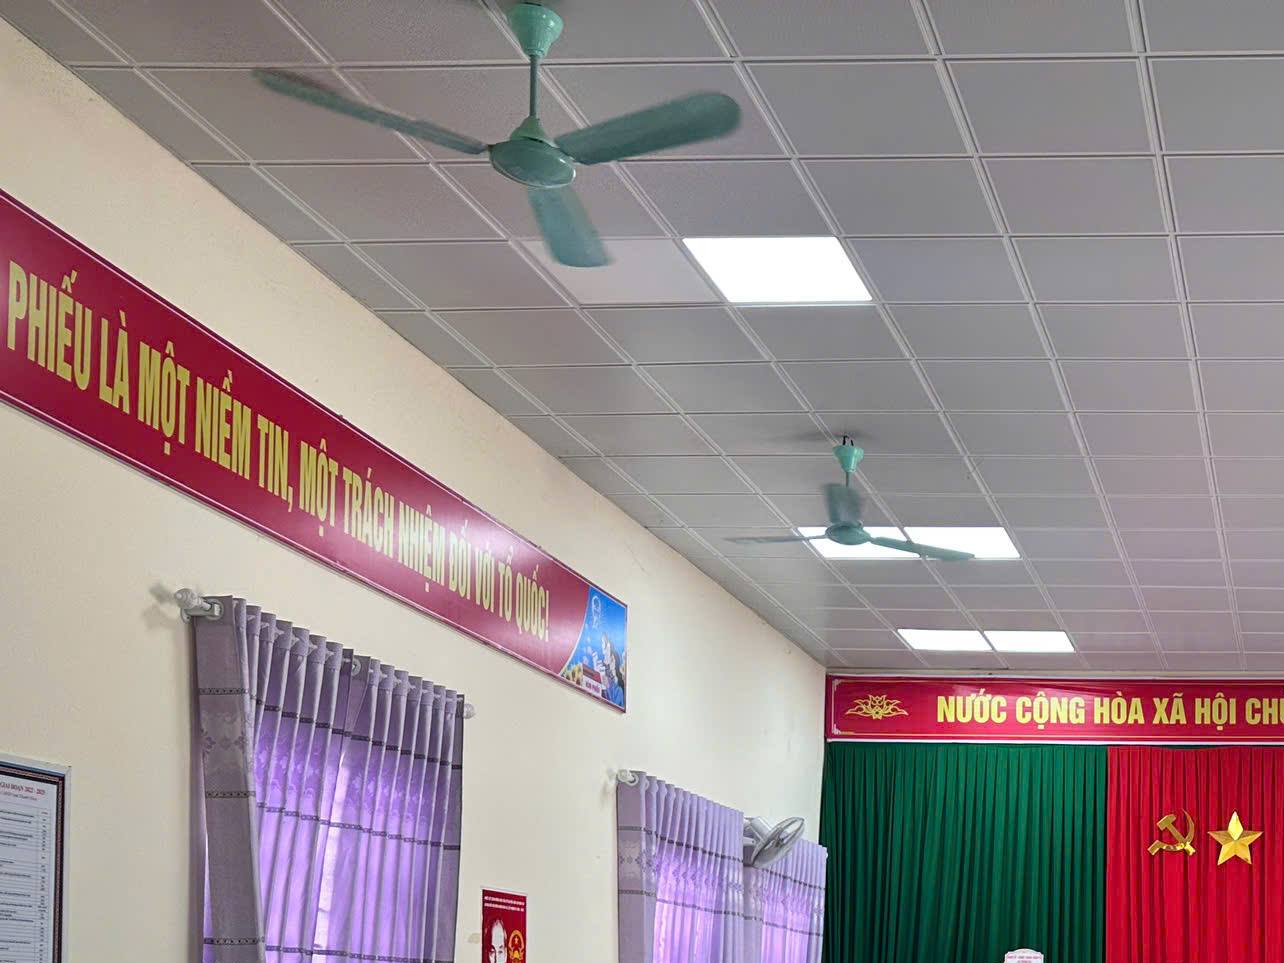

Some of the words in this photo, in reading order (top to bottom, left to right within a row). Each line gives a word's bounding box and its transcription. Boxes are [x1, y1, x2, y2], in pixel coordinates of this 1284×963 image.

[7, 260, 92, 391] PHIẾU
[99, 310, 130, 414] LÀ
[137, 340, 190, 456] MỘT
[195, 369, 252, 480] NIỀM
[257, 414, 293, 513] TIN,
[299, 438, 338, 537] MỘT
[343, 467, 394, 559] TRÁCH
[398, 504, 445, 592] NHIỆM
[449, 520, 471, 600] ĐỐI
[475, 541, 495, 613] VỚI
[498, 545, 514, 623] TỔ
[516, 564, 549, 642] QUỐC!
[937, 688, 1006, 724] NƯỚC
[1016, 691, 1086, 730] CỘNG
[1094, 692, 1144, 724] HÒA
[1153, 692, 1187, 724] XÃ
[1195, 692, 1238, 731] HỘI
